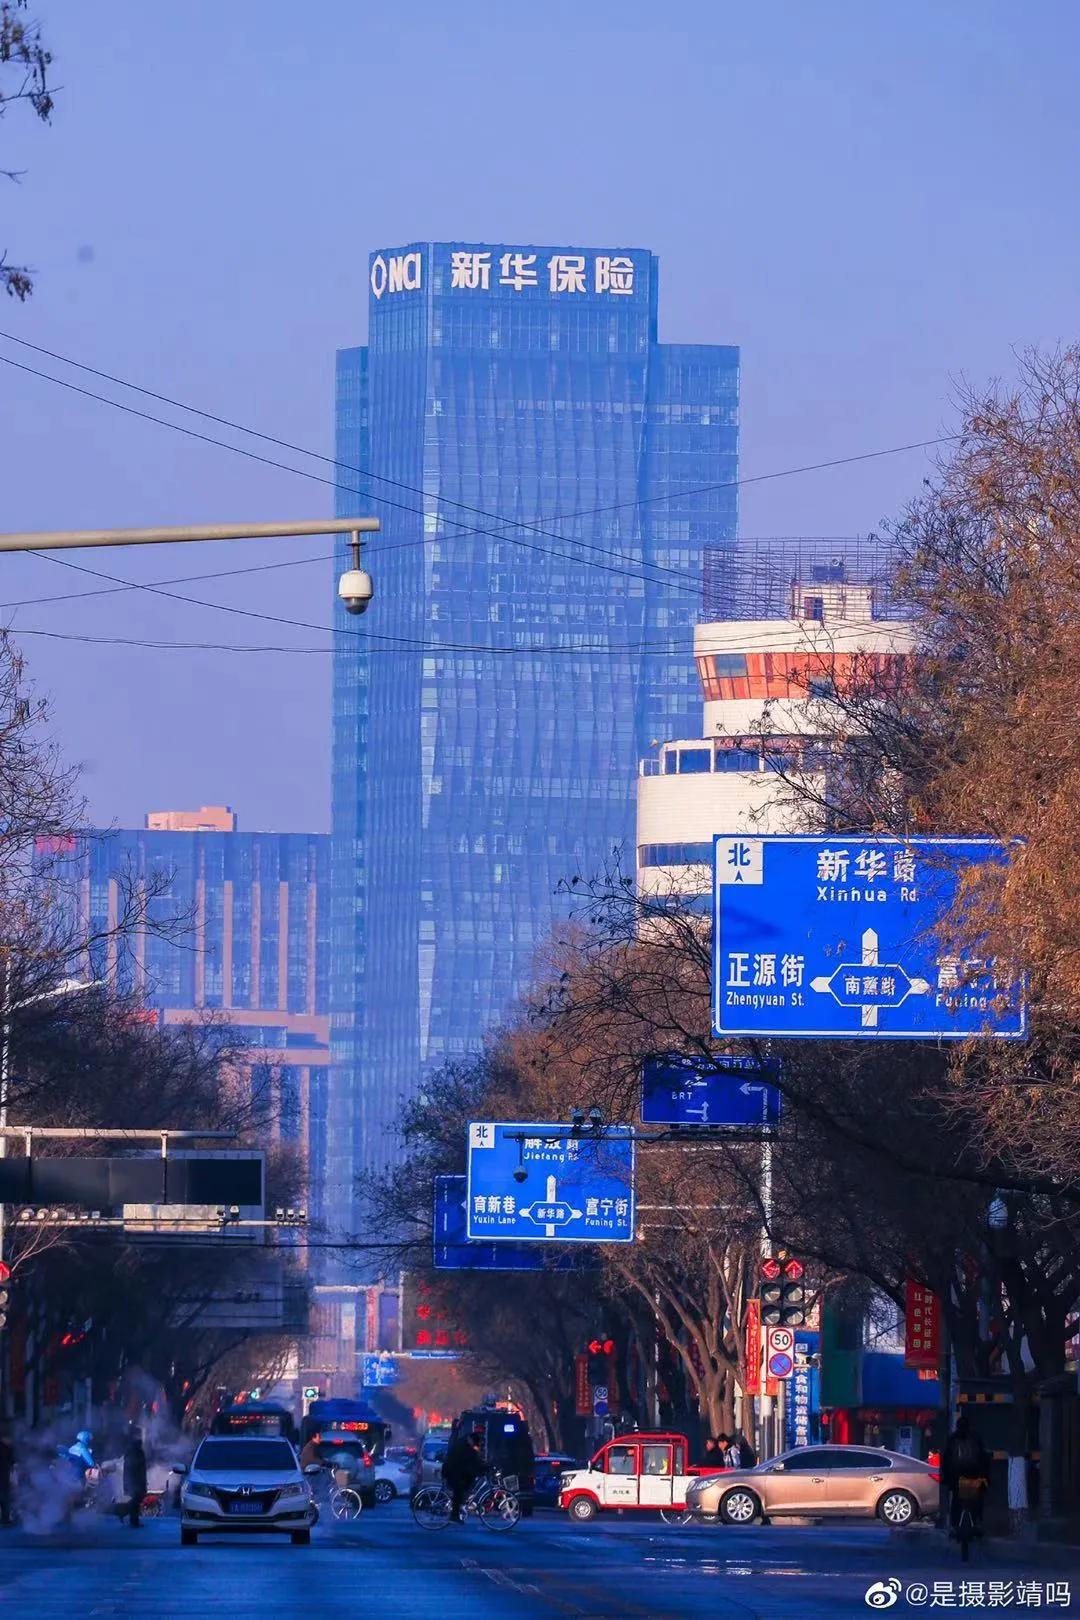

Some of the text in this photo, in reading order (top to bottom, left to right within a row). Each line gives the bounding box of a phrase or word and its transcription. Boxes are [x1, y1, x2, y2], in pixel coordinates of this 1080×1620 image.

[389, 252, 422, 293] NCI
[450, 252, 634, 295] 新华保险
[727, 842, 751, 867] 北
[816, 849, 915, 883] 新华路
[816, 886, 920, 902] Xinhua Rd.
[726, 953, 805, 987] 正源街
[726, 991, 804, 1009] Zhengyuan St.
[476, 1126, 488, 1139] 北
[524, 1152, 564, 1162] Jiefang
[473, 1196, 516, 1214] 育新巷
[585, 1198, 628, 1216] 富宁街
[473, 1216, 516, 1225] Yuxin Lane
[585, 1219, 628, 1228] Funing St.
[775, 1334, 789, 1345] 50
[795, 1343, 808, 1446] 国食和物资储备局
